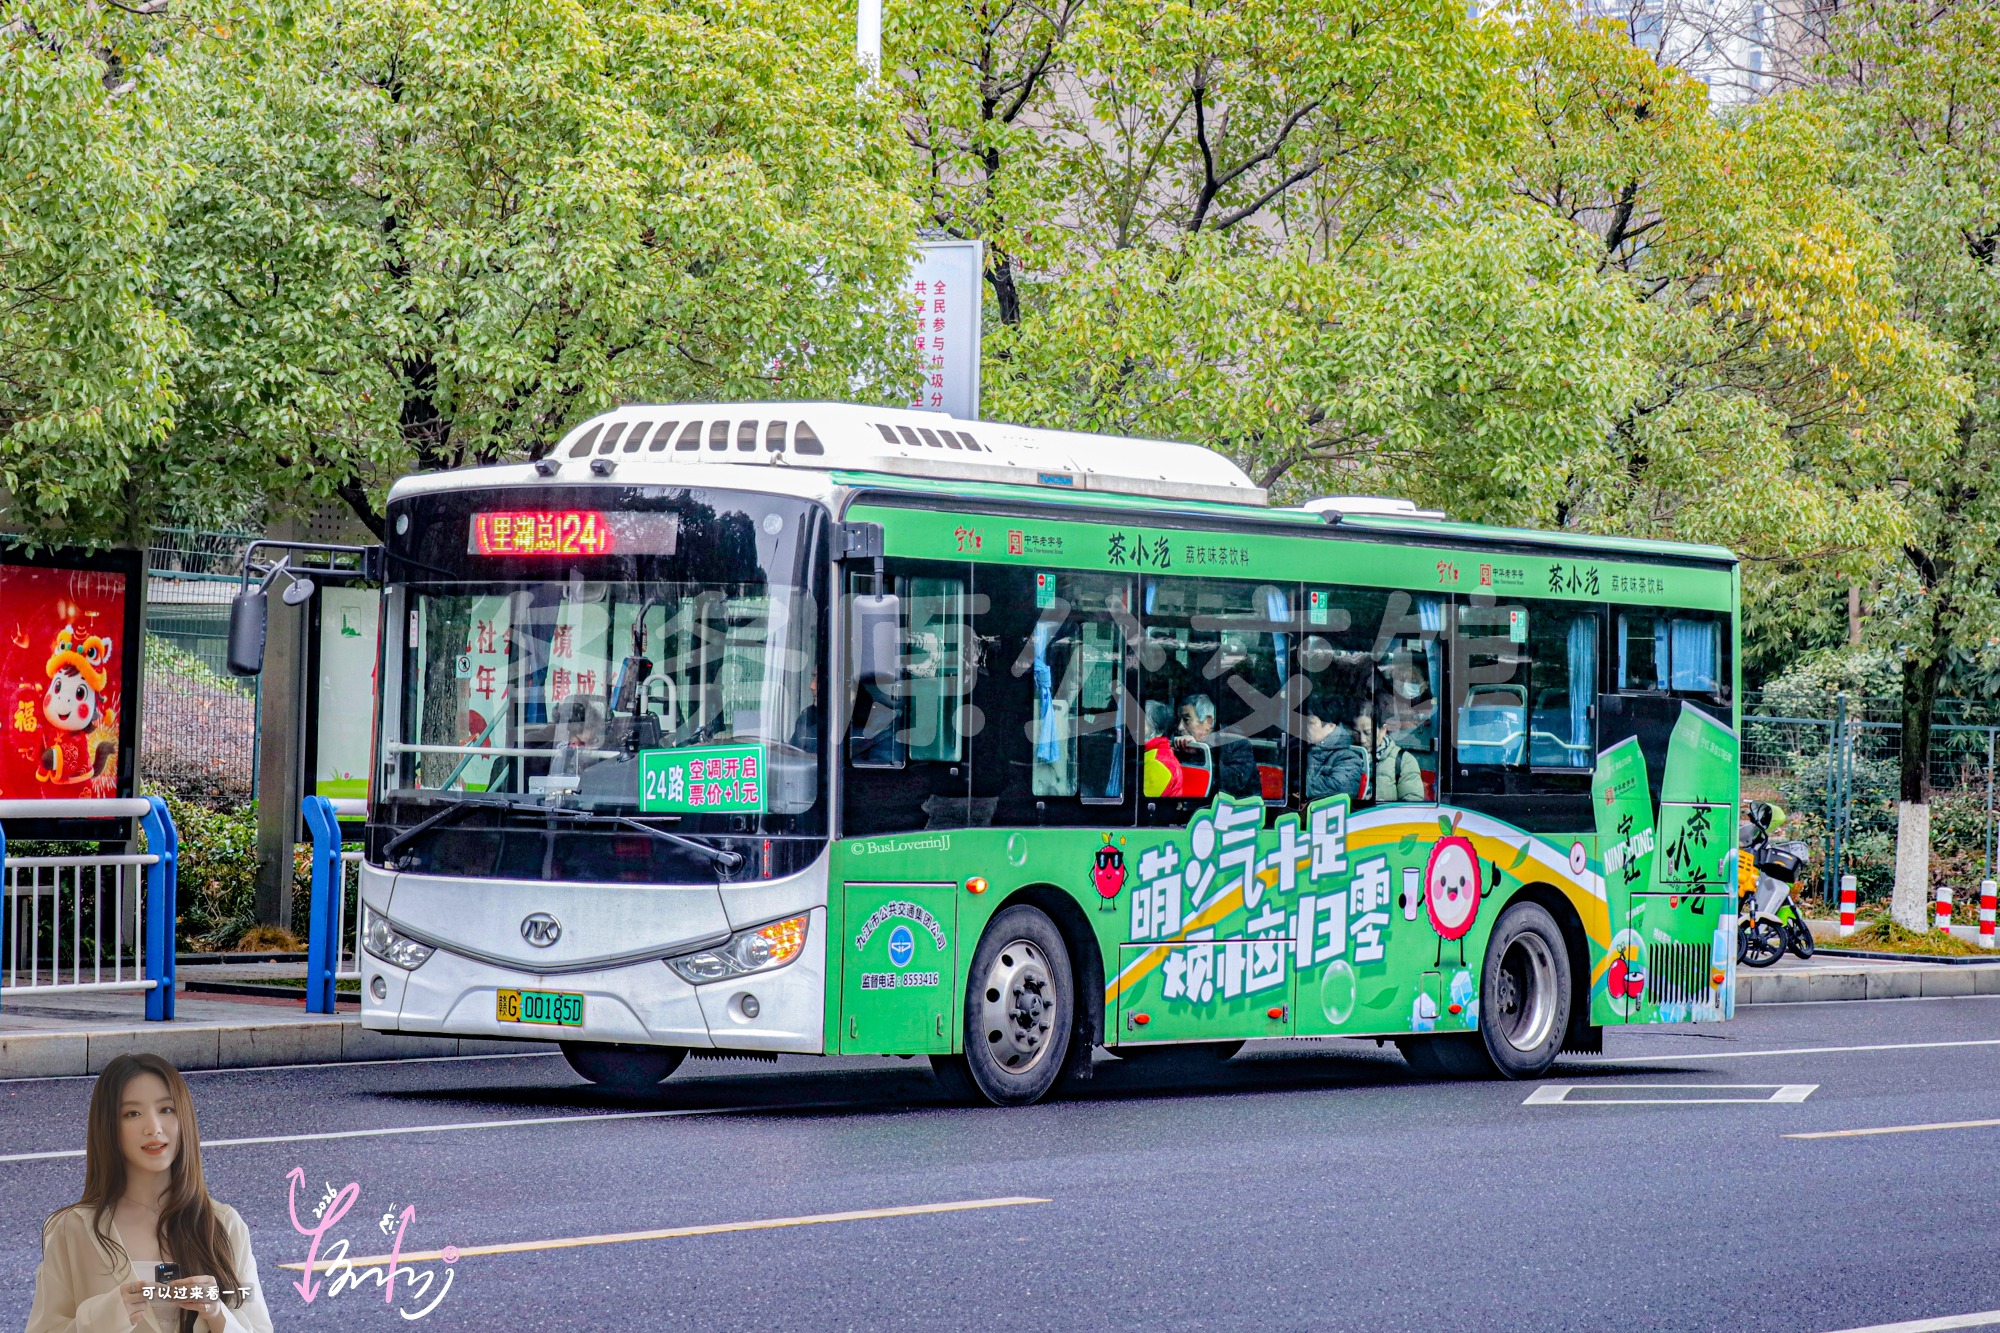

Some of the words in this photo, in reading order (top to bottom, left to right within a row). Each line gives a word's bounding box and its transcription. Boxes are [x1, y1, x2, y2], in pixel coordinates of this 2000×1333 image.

[931, 280, 946, 413] 全民参与垃圾分
[1107, 532, 1171, 568] 茶小汽
[1185, 544, 1249, 567] 荔枝味茶饮料
[1548, 563, 1600, 596] 茶小汽
[1611, 575, 1664, 595] 荔枝味茶饮料
[14, 700, 38, 733] 福
[646, 764, 684, 802] 24路
[688, 756, 757, 781] 空调开启
[688, 779, 759, 807] 票价+1元
[855, 900, 947, 951] 九江市公共交通集团公司
[1162, 857, 1391, 1003] 烦恼归零
